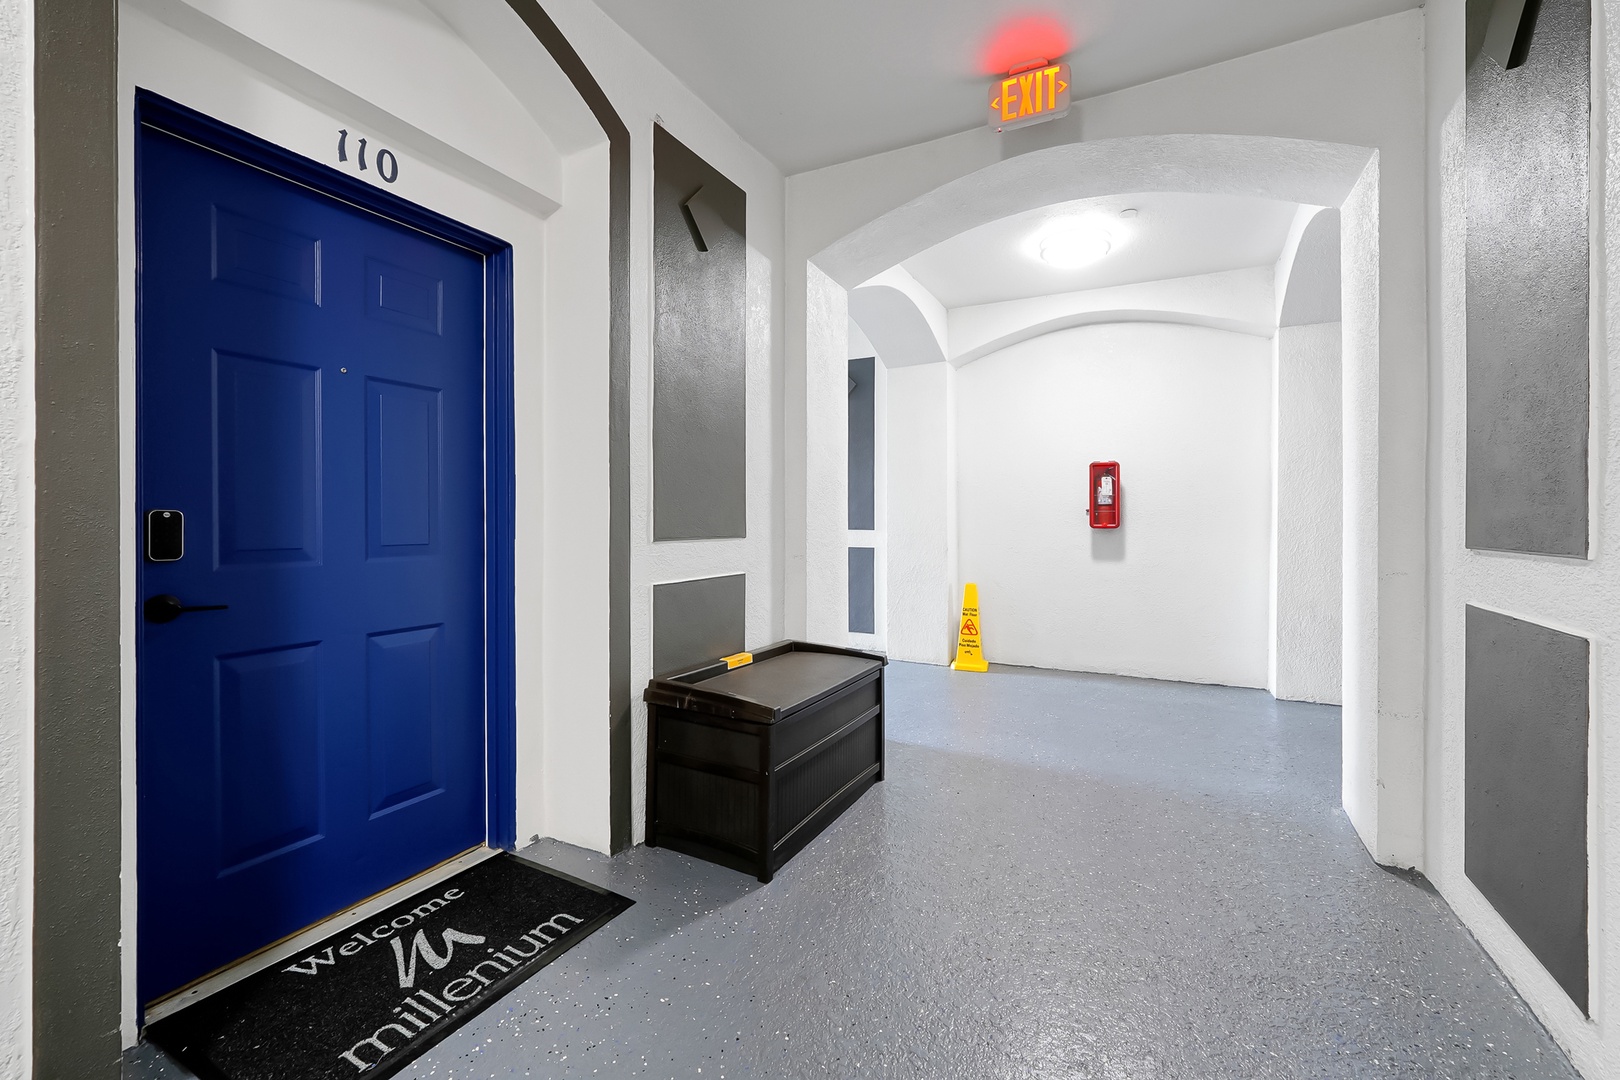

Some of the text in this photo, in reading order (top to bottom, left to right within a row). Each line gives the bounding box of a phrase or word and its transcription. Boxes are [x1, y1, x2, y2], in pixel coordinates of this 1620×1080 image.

[1002, 66, 1060, 122] EXIT
[338, 129, 398, 184] 110
[281, 887, 466, 976] Welcome
[338, 912, 585, 1074] millenium
